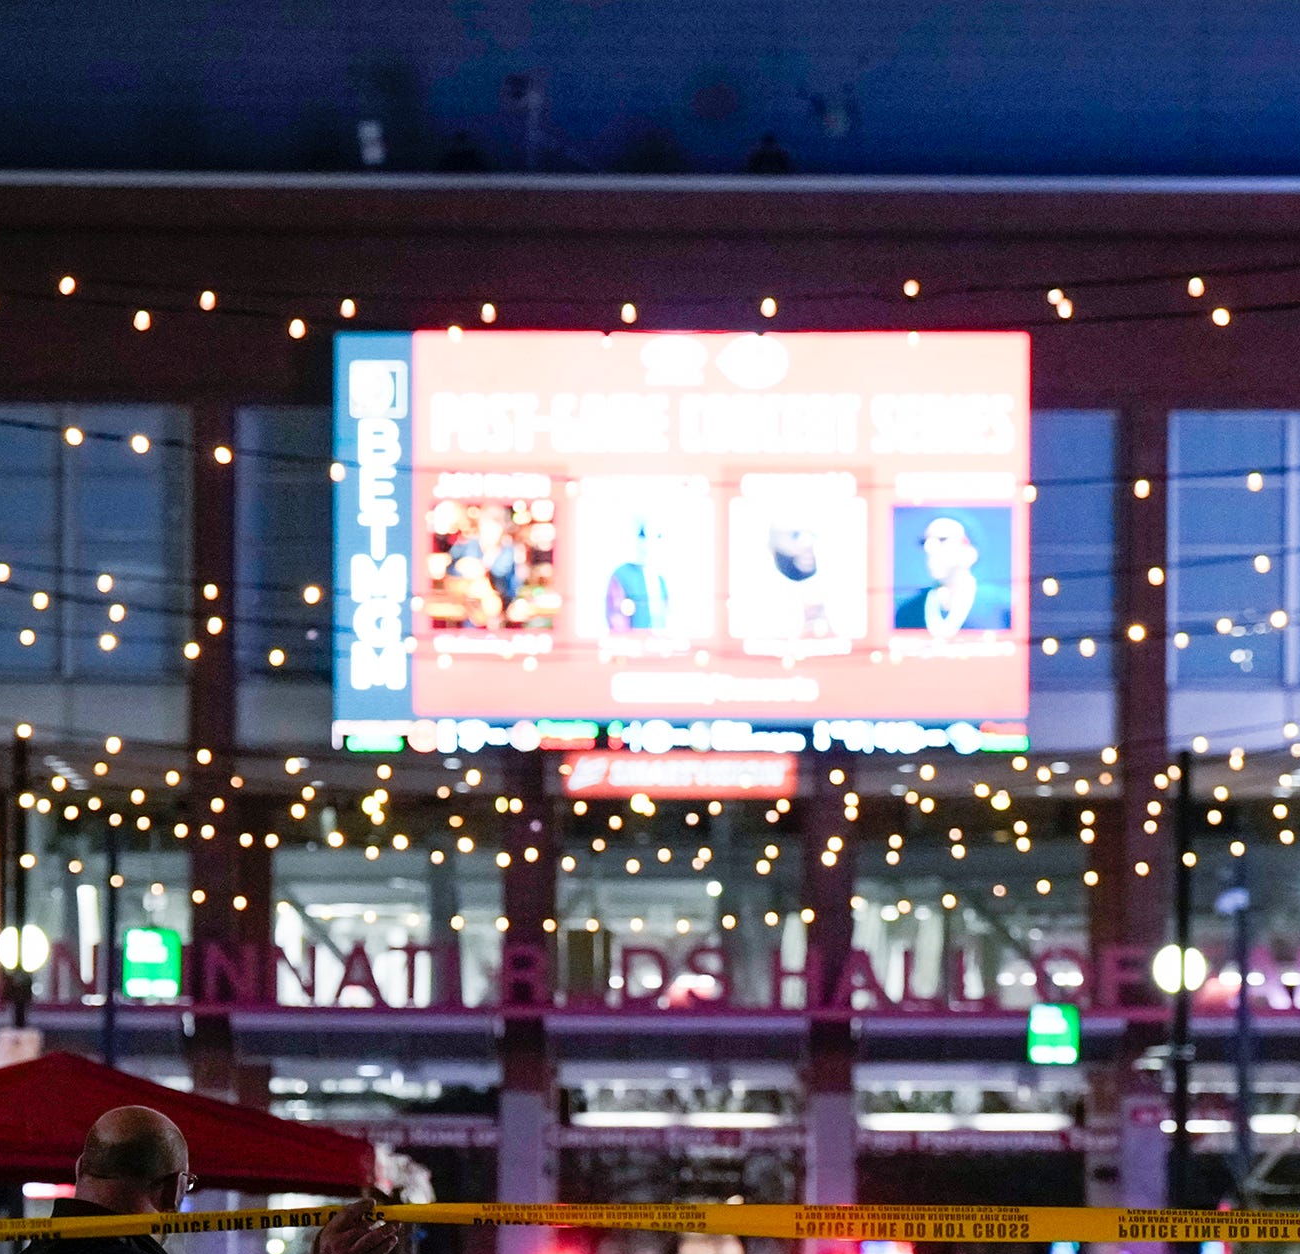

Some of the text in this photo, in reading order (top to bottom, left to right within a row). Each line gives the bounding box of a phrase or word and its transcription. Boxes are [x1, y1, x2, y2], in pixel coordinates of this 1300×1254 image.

[151, 1221, 210, 1234] POLICE
[218, 1217, 253, 1231] LINE
[260, 1215, 283, 1229] DO
[289, 1212, 322, 1228] NOT
